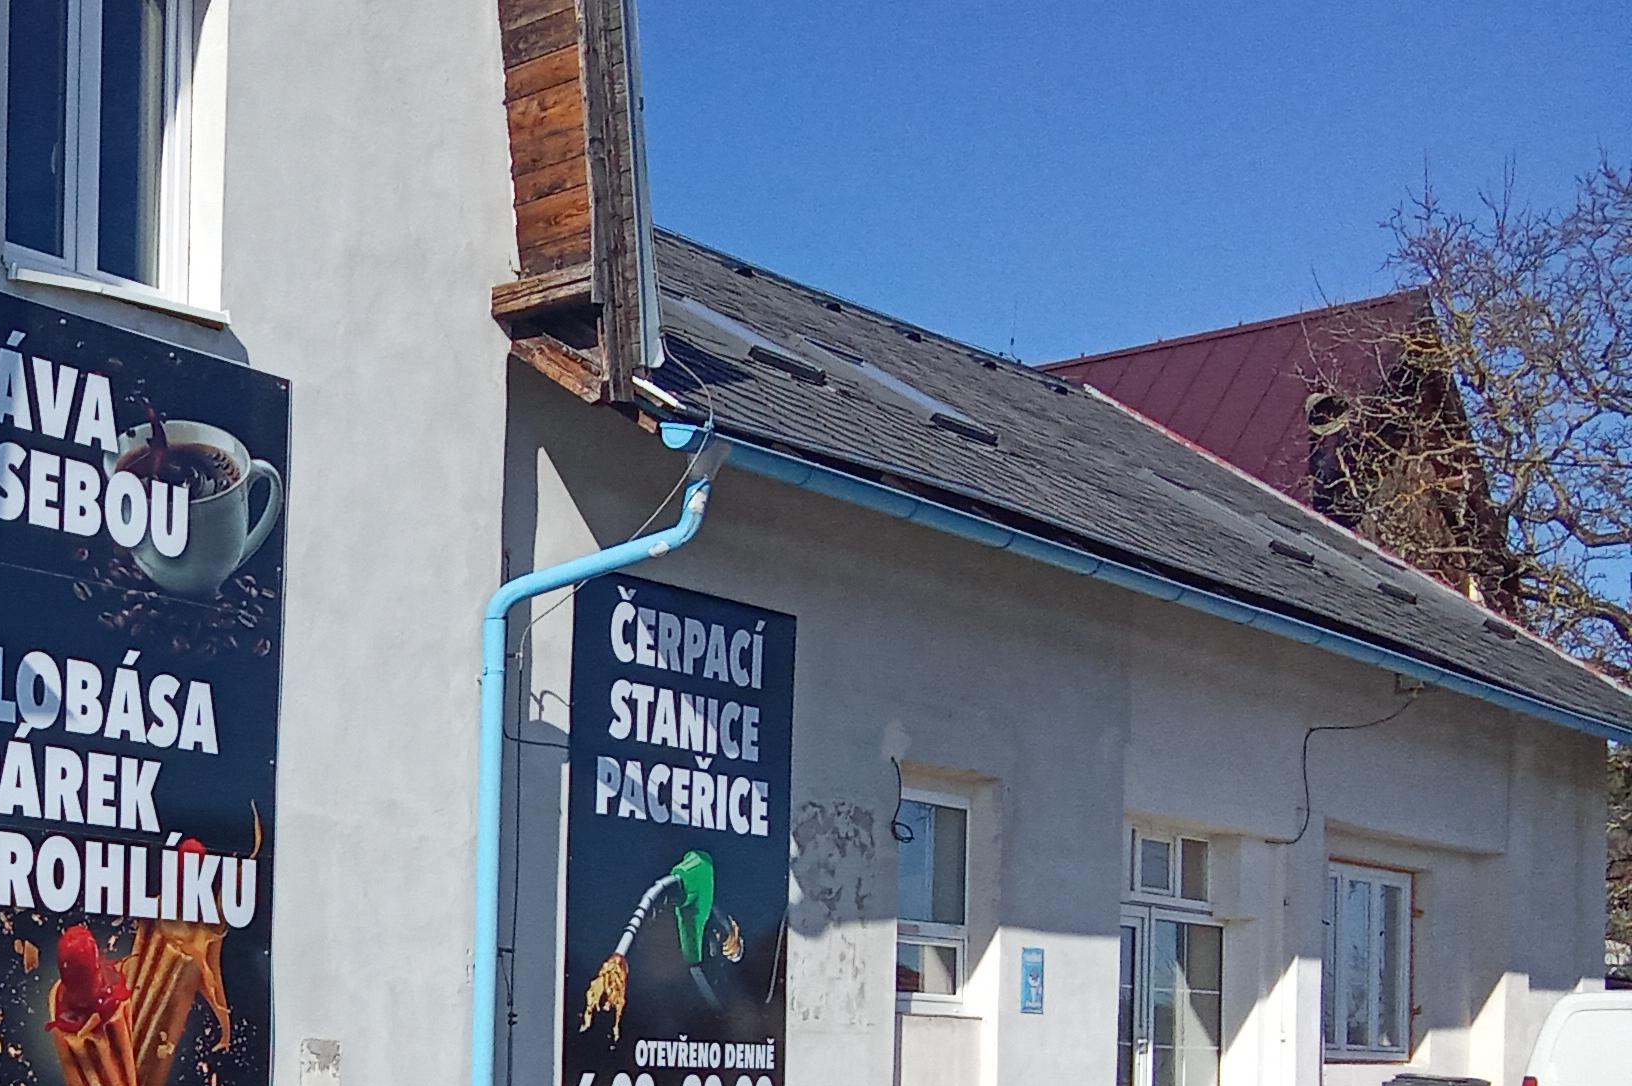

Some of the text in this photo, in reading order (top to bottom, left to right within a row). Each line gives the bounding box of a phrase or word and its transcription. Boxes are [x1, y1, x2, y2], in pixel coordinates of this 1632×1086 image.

[610, 585, 766, 690] ČERPACÍ
[608, 679, 760, 763] STANICE
[595, 755, 769, 837] PACEŘICE
[635, 1034, 775, 1070] OTEVŘENO DENNĚ
